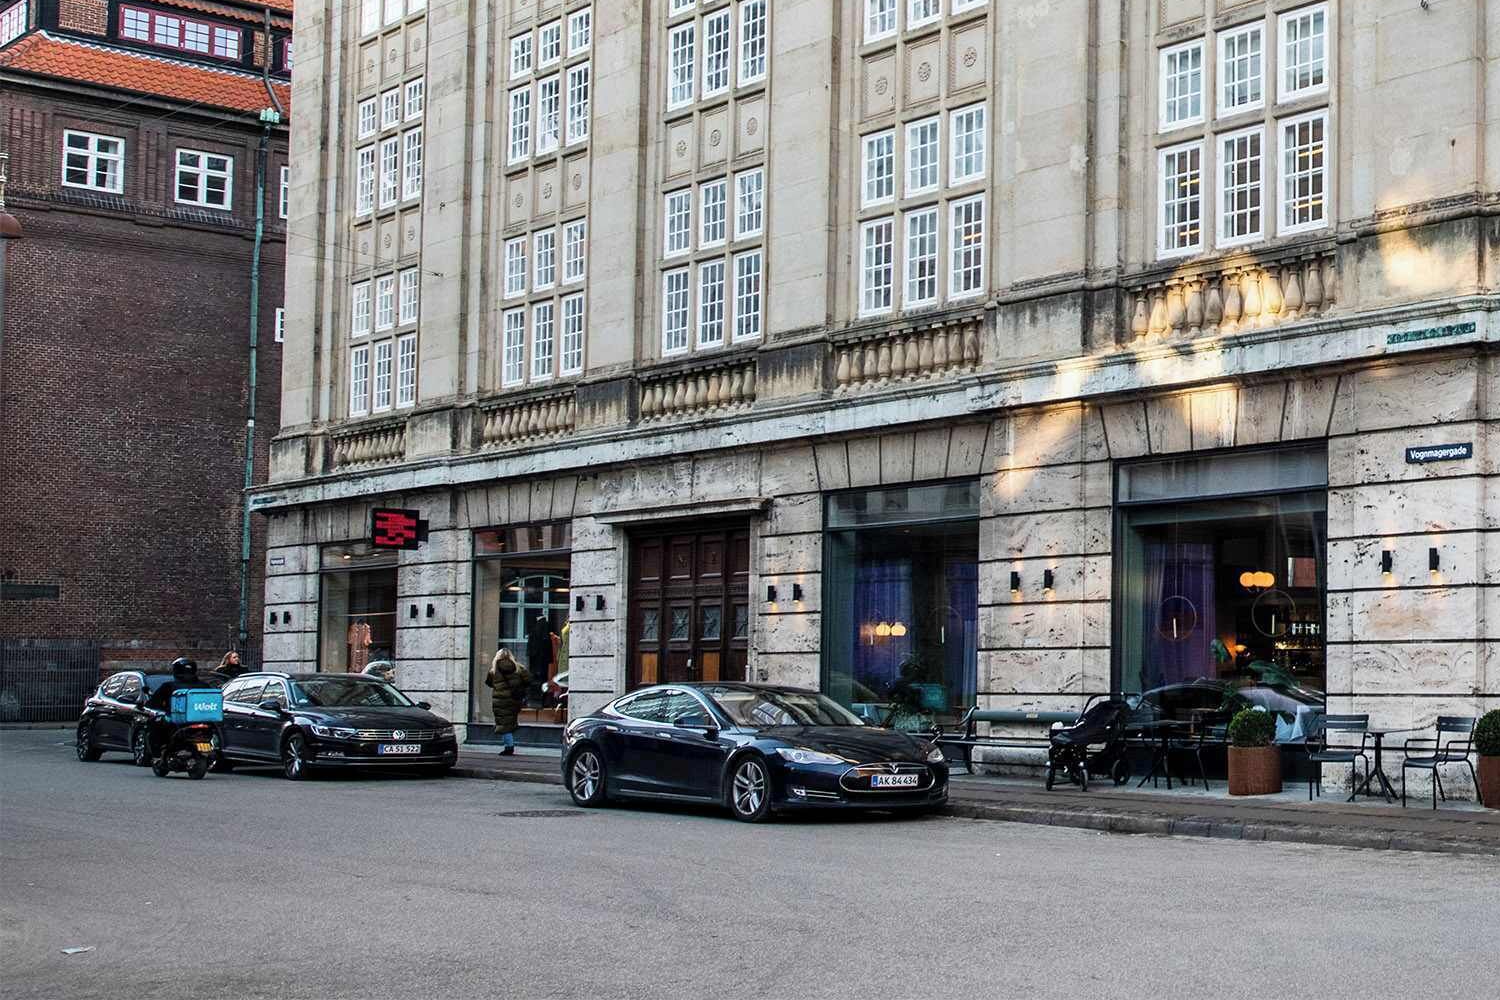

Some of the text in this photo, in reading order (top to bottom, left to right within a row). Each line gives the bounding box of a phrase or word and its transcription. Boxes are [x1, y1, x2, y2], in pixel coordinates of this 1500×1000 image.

[1410, 445, 1467, 460] Vognmagergade
[193, 702, 218, 712] Wolt
[879, 776, 890, 785] AK
[891, 776, 902, 785] 84
